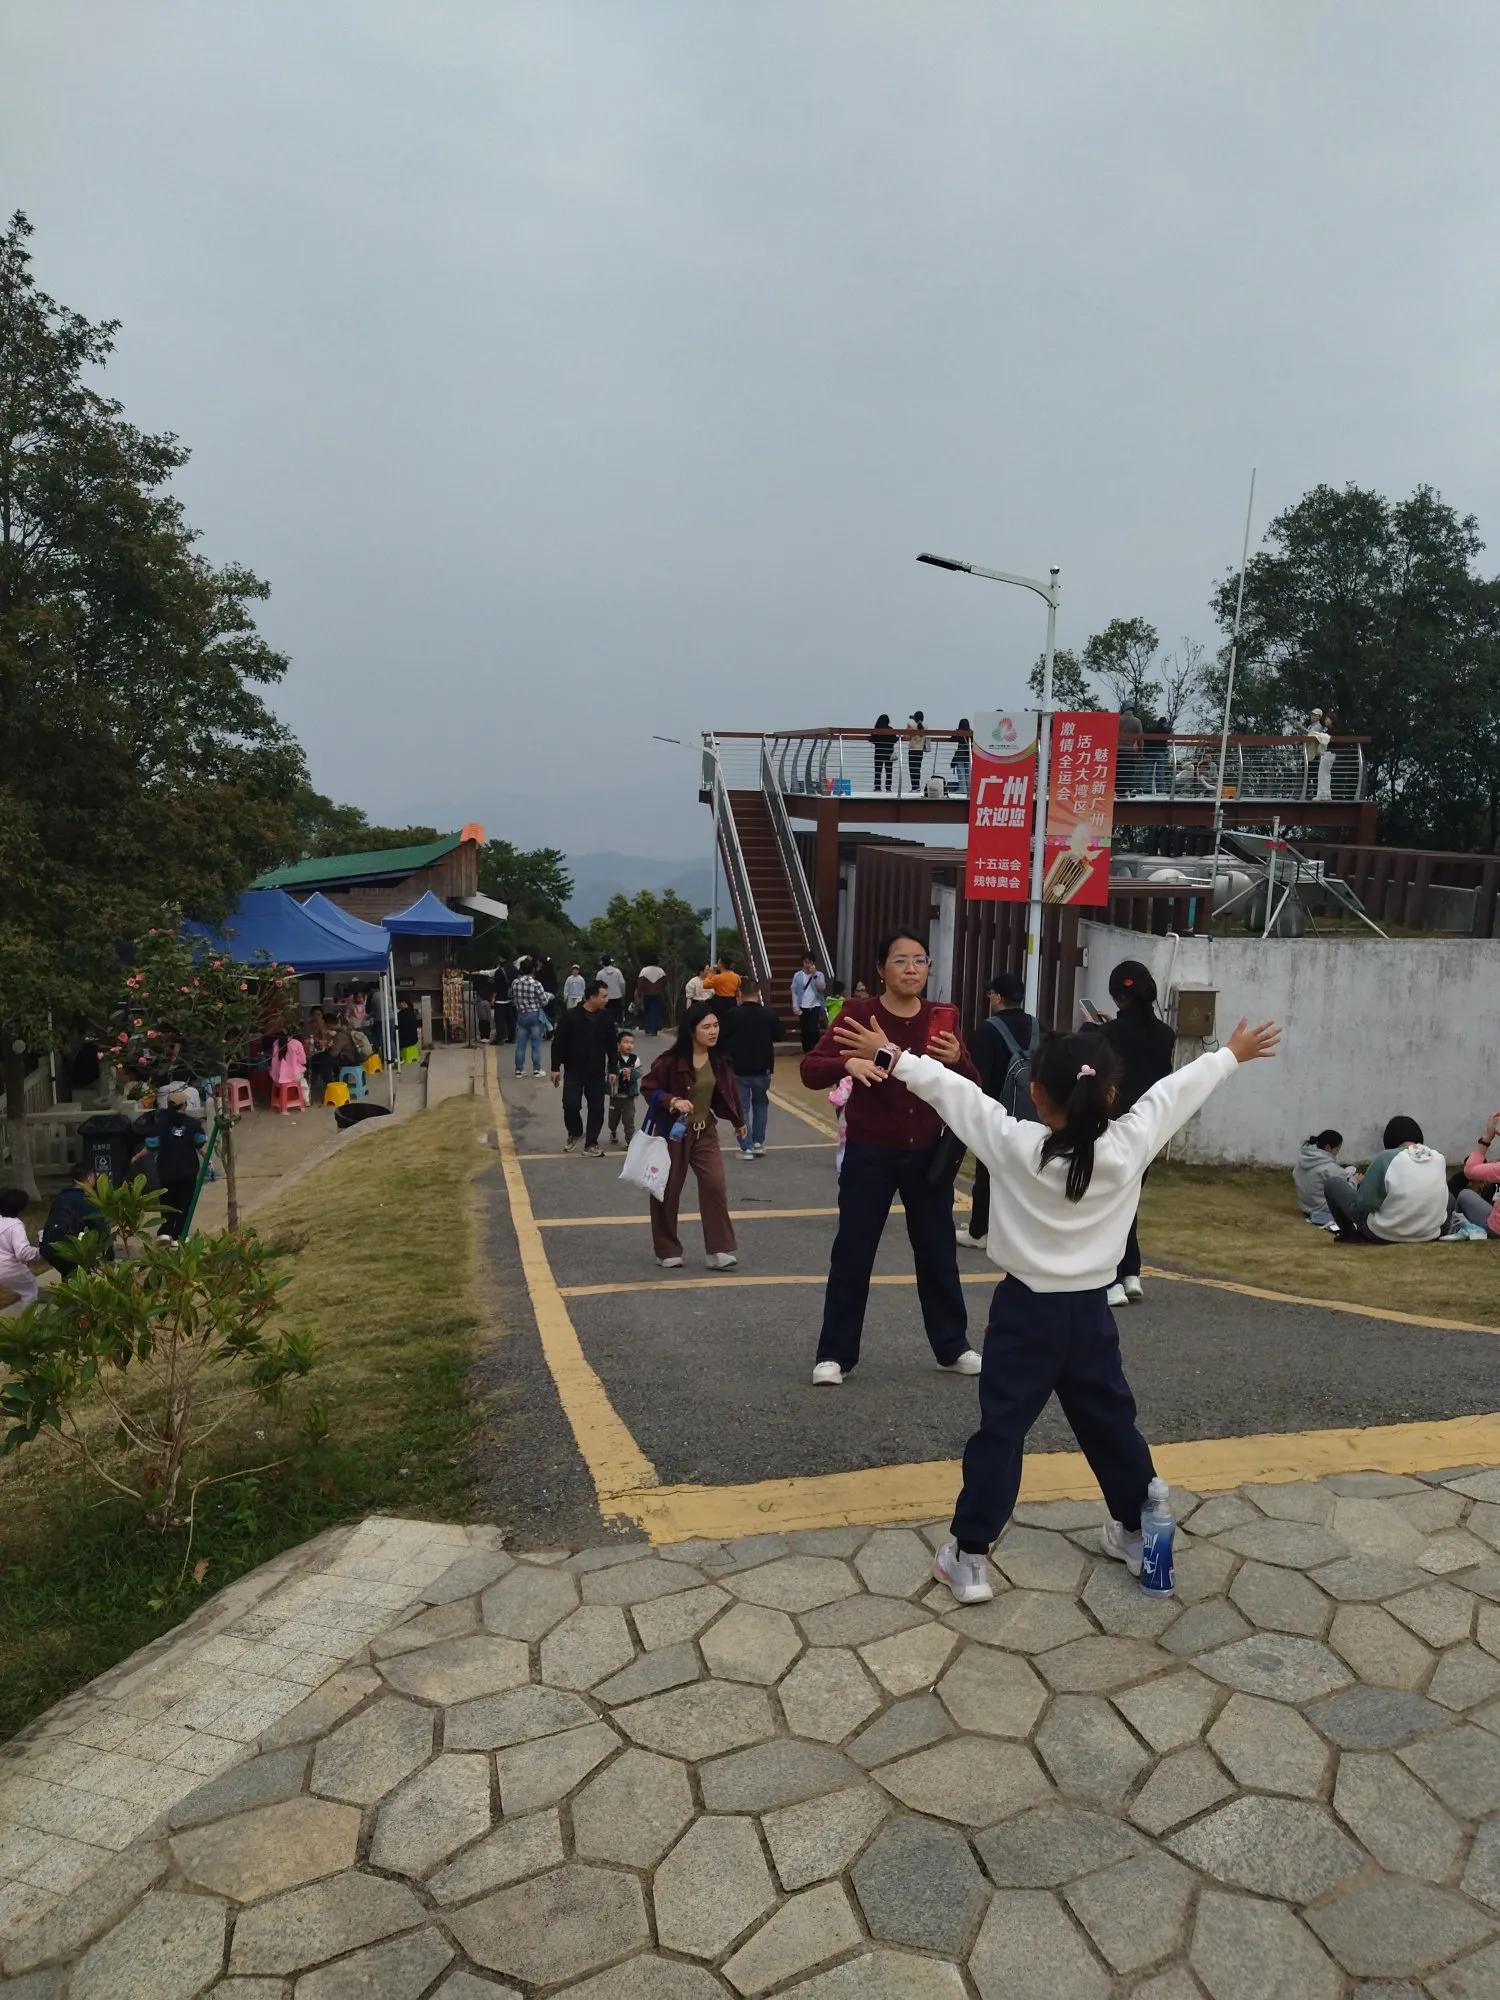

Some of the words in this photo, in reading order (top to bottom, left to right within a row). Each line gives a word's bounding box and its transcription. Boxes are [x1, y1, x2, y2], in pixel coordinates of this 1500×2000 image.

[1056, 722, 1076, 801] 激情全运会
[1073, 734, 1092, 814] 活力大湾区
[976, 775, 1028, 805] 广州
[1089, 748, 1109, 826] 魅力新广州
[975, 807, 1025, 827] 欢迎您
[975, 858, 1021, 871] 十五运会
[973, 875, 1021, 889] 残特奥会
